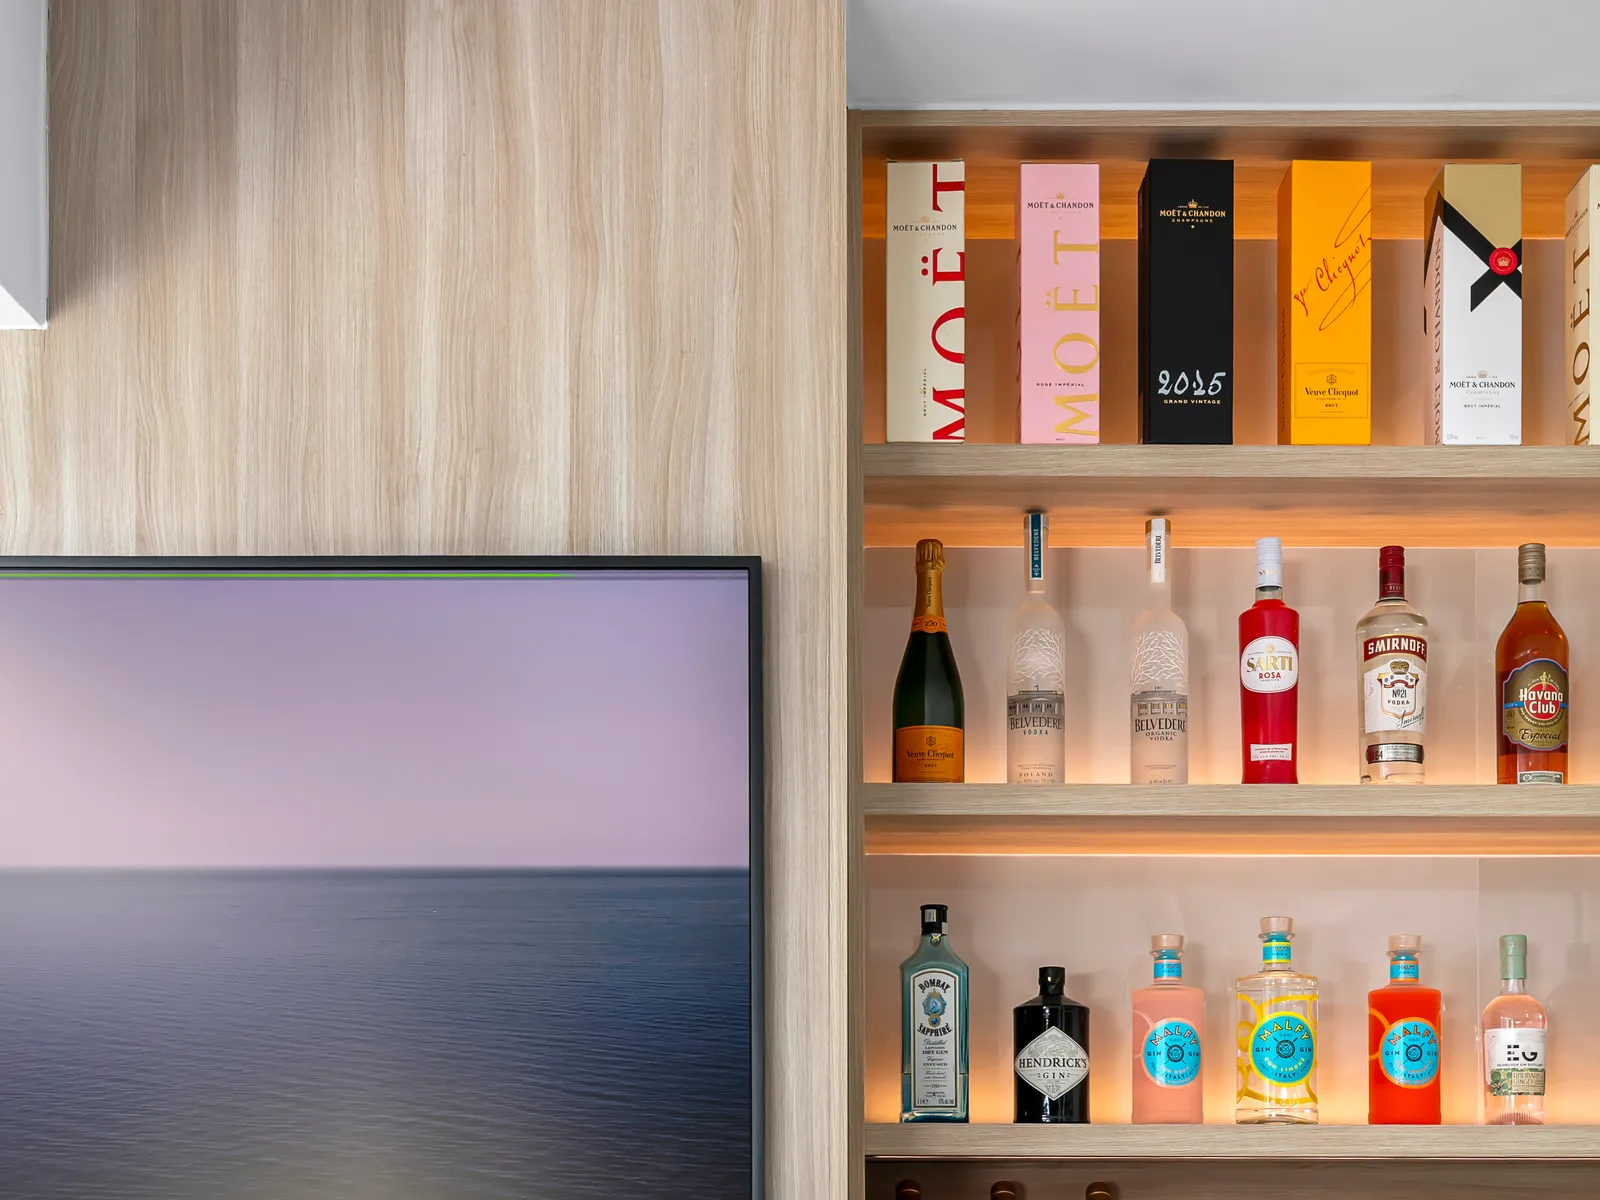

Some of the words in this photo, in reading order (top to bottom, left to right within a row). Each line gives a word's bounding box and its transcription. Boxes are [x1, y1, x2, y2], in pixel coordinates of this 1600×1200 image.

[1160, 209, 1181, 217] MOËT
[1046, 230, 1099, 438] MOËT
[1570, 245, 1590, 445] MOËT
[1157, 369, 1226, 396] 2015
[1479, 381, 1516, 389] CHANDON
[1305, 387, 1326, 396] Veuve
[1328, 387, 1359, 398] Clicquot
[1368, 637, 1425, 655] SMIRNOFF
[1246, 655, 1293, 672] SARTI
[1519, 688, 1563, 701] Havana
[1529, 701, 1556, 714] Club
[1010, 716, 1062, 730] BELVEDERE
[1135, 718, 1186, 733] BELVEDERE
[1519, 728, 1561, 742] Especial
[906, 750, 926, 759] Veuve
[927, 749, 954, 760] Clicquot
[918, 979, 951, 993] BOMBAY
[917, 1022, 953, 1037] SAPPHIRE
[1150, 1025, 1198, 1047] MALFY
[1259, 1020, 1310, 1042] MALFY
[1388, 1025, 1437, 1047] MALFY
[1019, 1057, 1087, 1068] HENDRICK'S
[1264, 1057, 1277, 1070] CON
[1280, 1057, 1305, 1072] LIMONE
